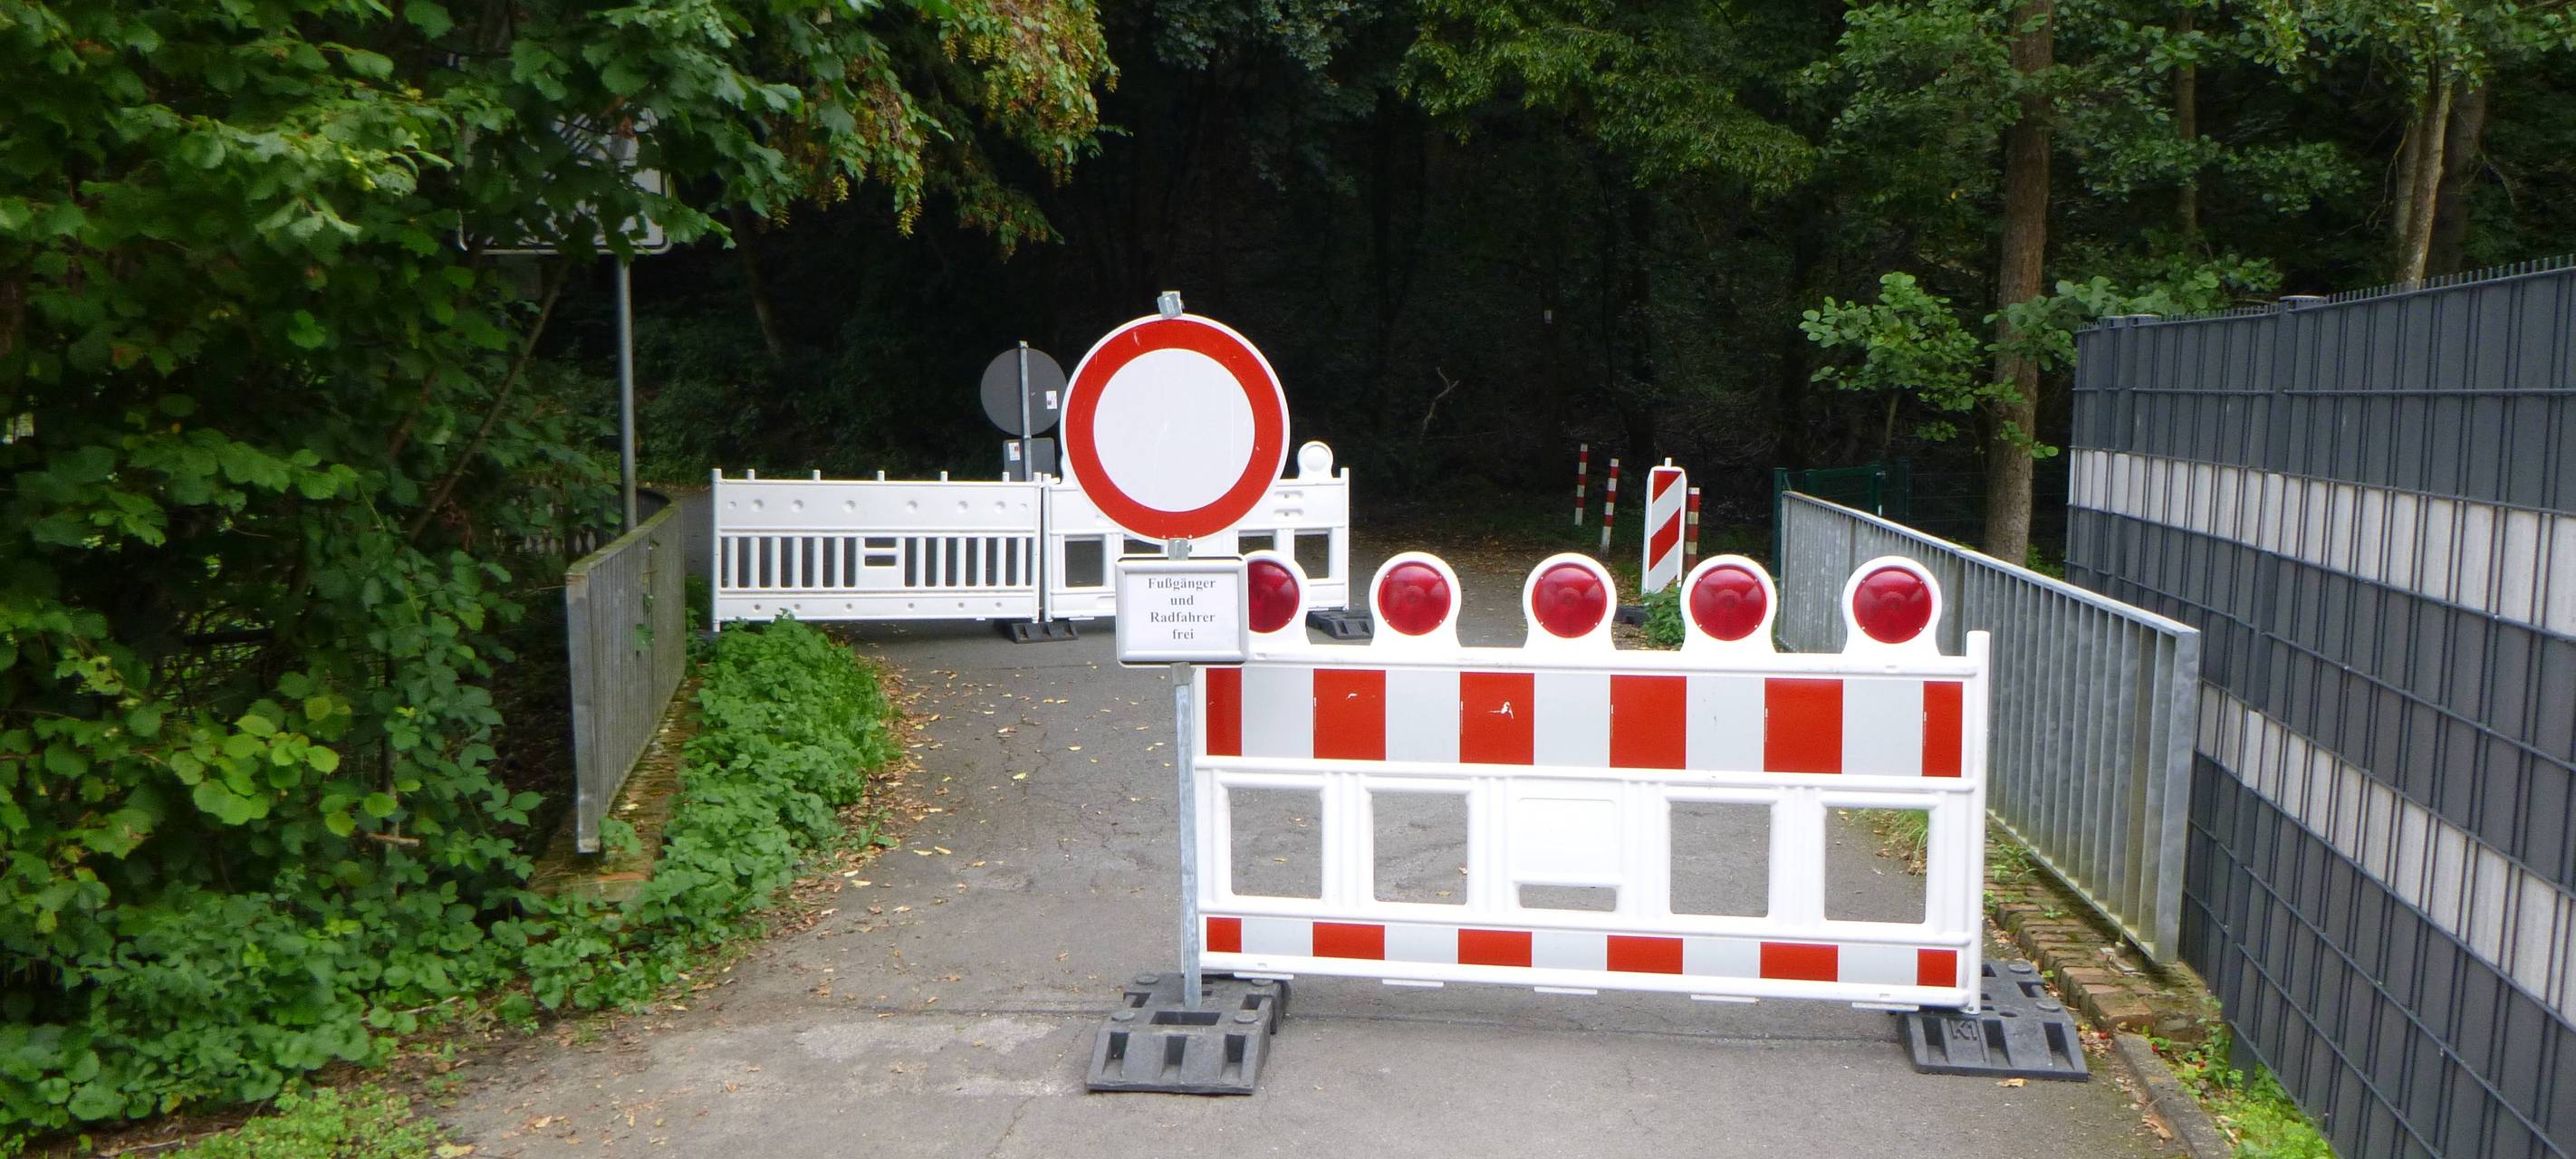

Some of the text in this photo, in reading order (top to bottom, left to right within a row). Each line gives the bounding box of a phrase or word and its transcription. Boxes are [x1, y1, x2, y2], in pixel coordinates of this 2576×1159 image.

[1149, 578, 1216, 591] Fußgänger
[1170, 595, 1194, 606] und
[1150, 612, 1216, 623] Radfahrer
[1173, 628, 1195, 639] frei
